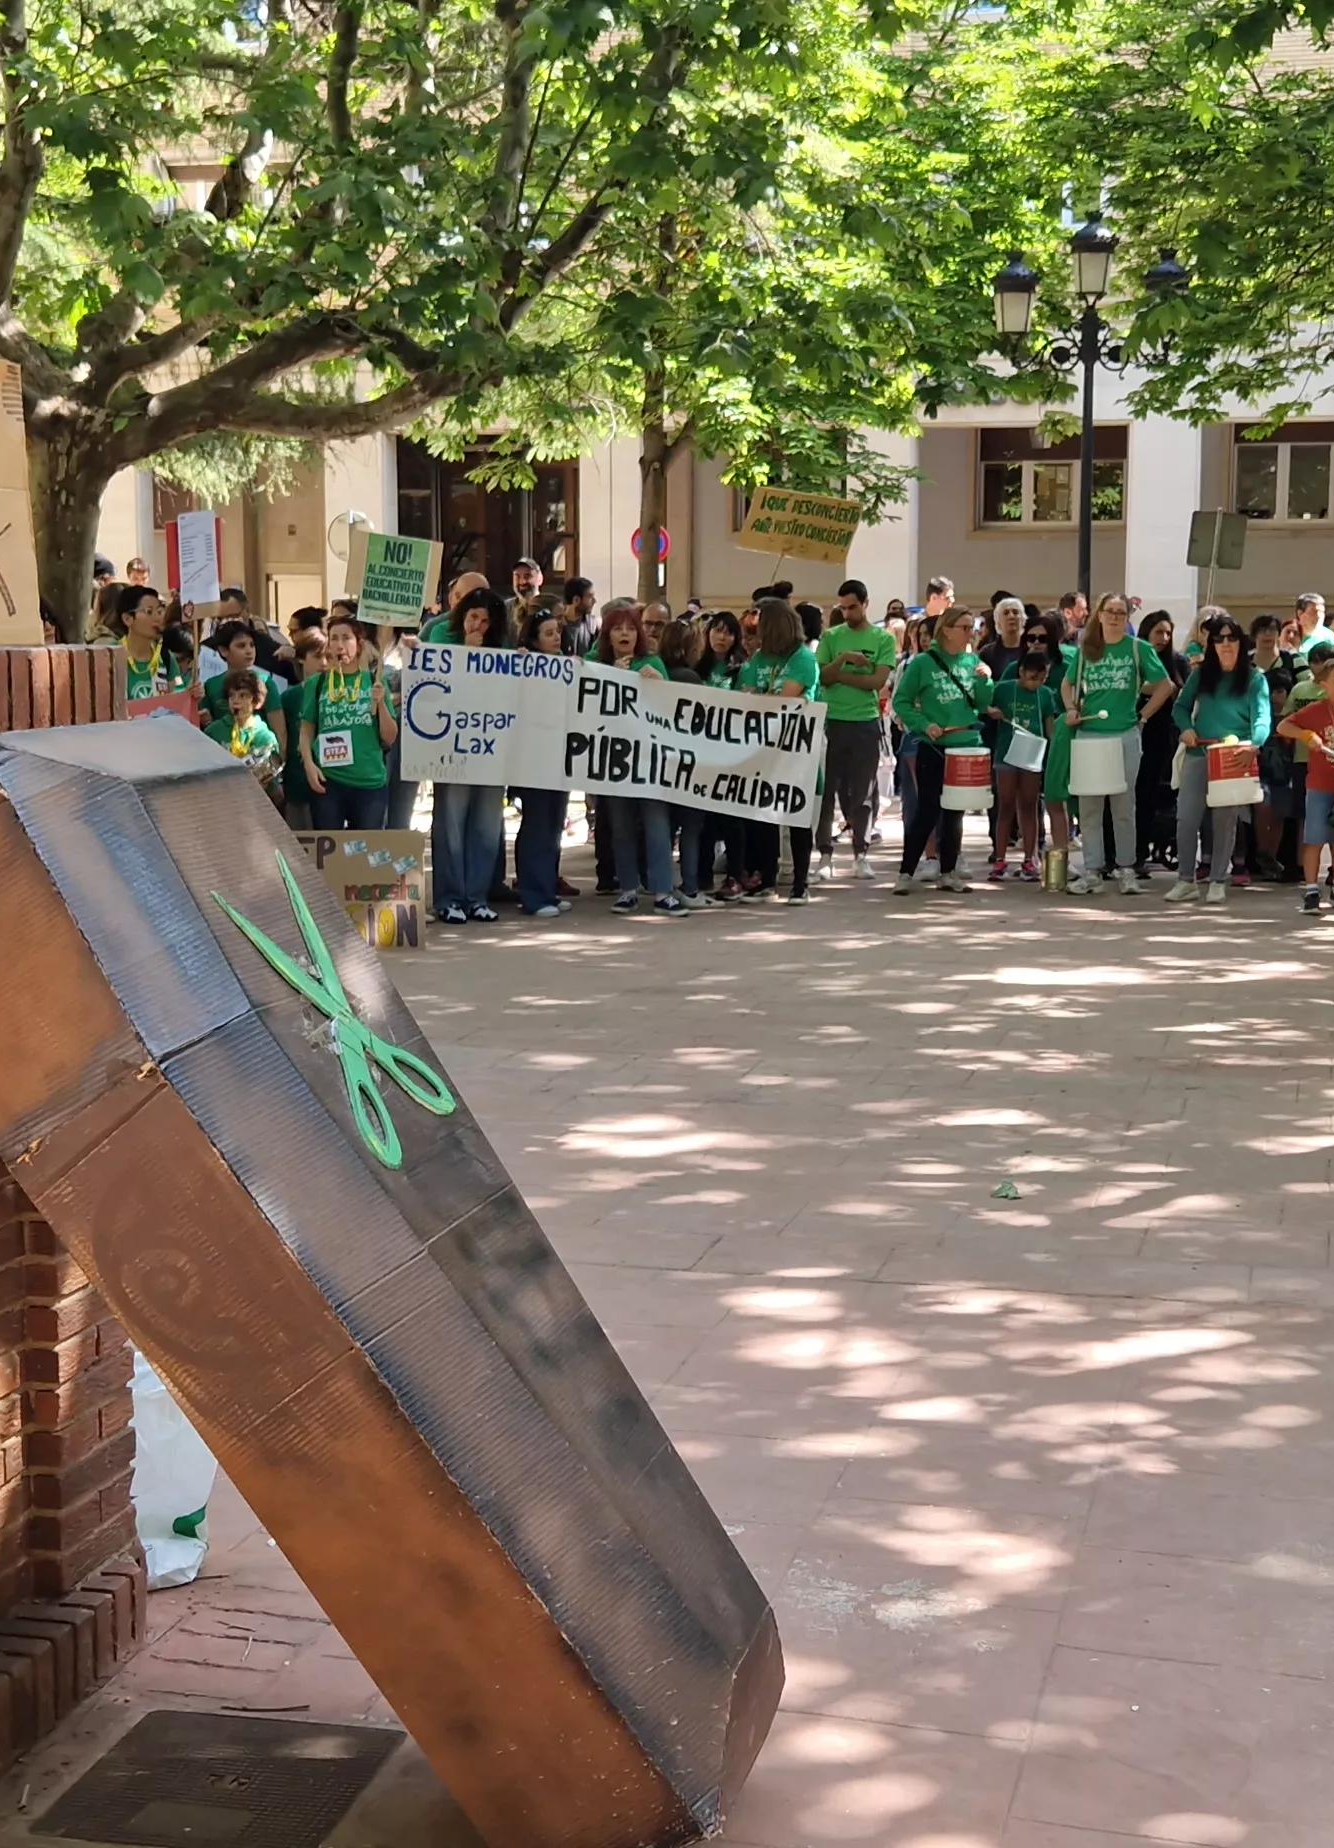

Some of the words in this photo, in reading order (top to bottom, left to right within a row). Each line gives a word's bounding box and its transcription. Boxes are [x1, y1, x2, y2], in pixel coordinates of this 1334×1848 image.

[383, 541, 413, 566] NO!
[366, 576, 411, 593] EDUCATIVO
[378, 565, 425, 583] CONCIERTO
[362, 588, 422, 608] BACHILLERATO
[408, 648, 453, 675] IES
[466, 651, 575, 686] MONEGROS
[406, 680, 516, 741] Gaspar
[577, 676, 639, 719] POR
[645, 711, 671, 731] UNA
[673, 695, 816, 754] EDUCACIÓN
[454, 732, 496, 756] Lax
[564, 726, 696, 792] PÚBLICA
[710, 771, 806, 814] CALIDAD
